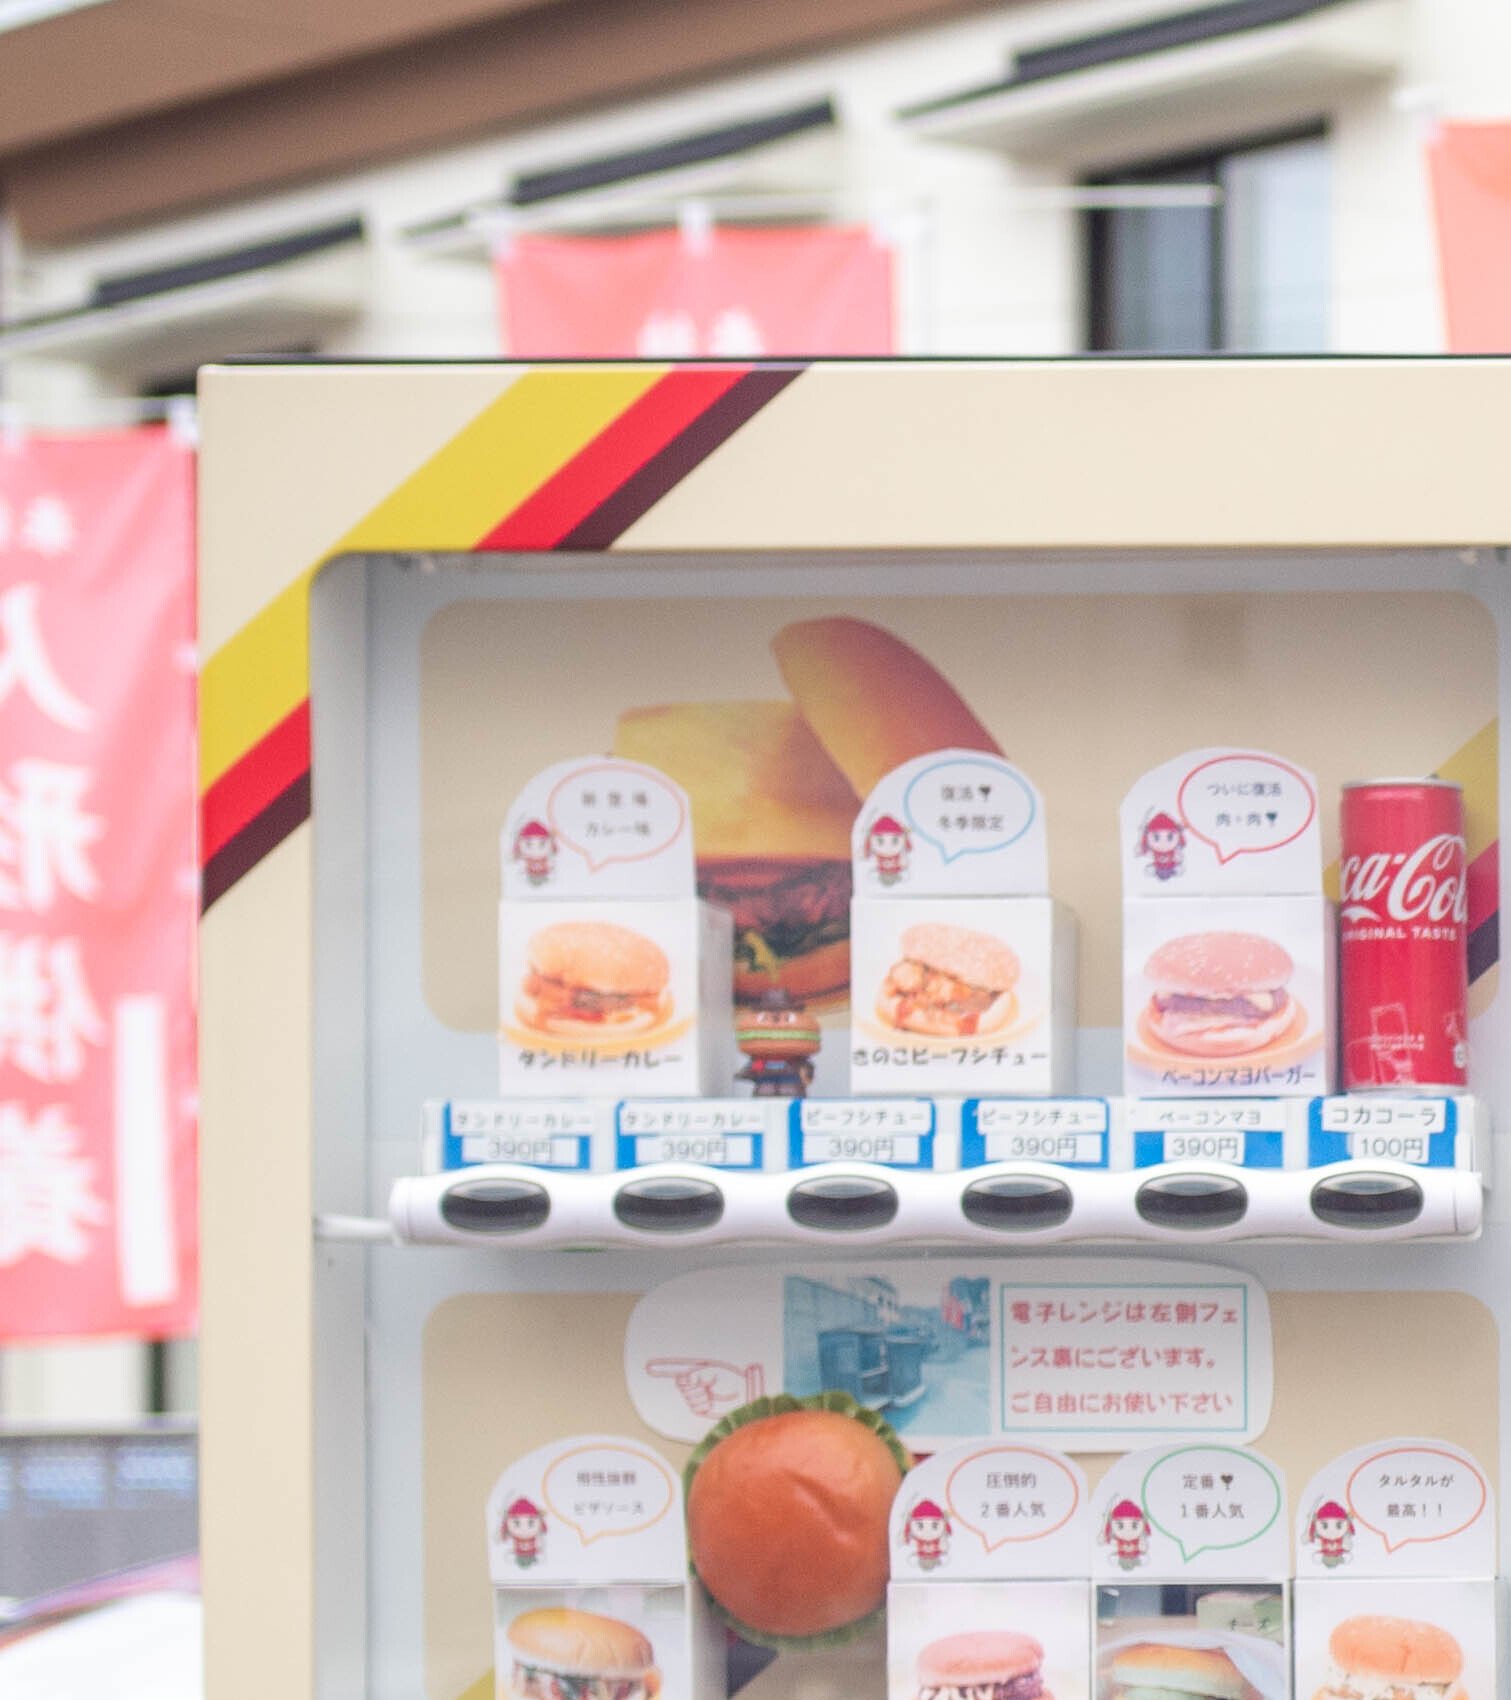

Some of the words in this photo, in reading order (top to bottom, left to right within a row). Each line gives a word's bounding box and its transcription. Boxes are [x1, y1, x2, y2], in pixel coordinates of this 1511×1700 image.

[1160, 1065, 1316, 1087] ベーコンマヨバーガー
[1331, 1106, 1439, 1127] コカコーラ
[488, 1138, 554, 1162] 390円
[662, 1137, 728, 1162] 390円
[828, 1136, 896, 1161] 390円
[1010, 1135, 1078, 1159] 390円
[1172, 1135, 1239, 1160] 390円
[1360, 1135, 1424, 1160] 100円
[1010, 1301, 1239, 1325] 電子レンジは左側フェ
[1010, 1345, 1218, 1371] ンス裏にございます。
[1009, 1390, 1234, 1415] ご自由にお使い下さい
[985, 1473, 1038, 1489] 圧倒的
[1378, 1473, 1455, 1489] タルタルが
